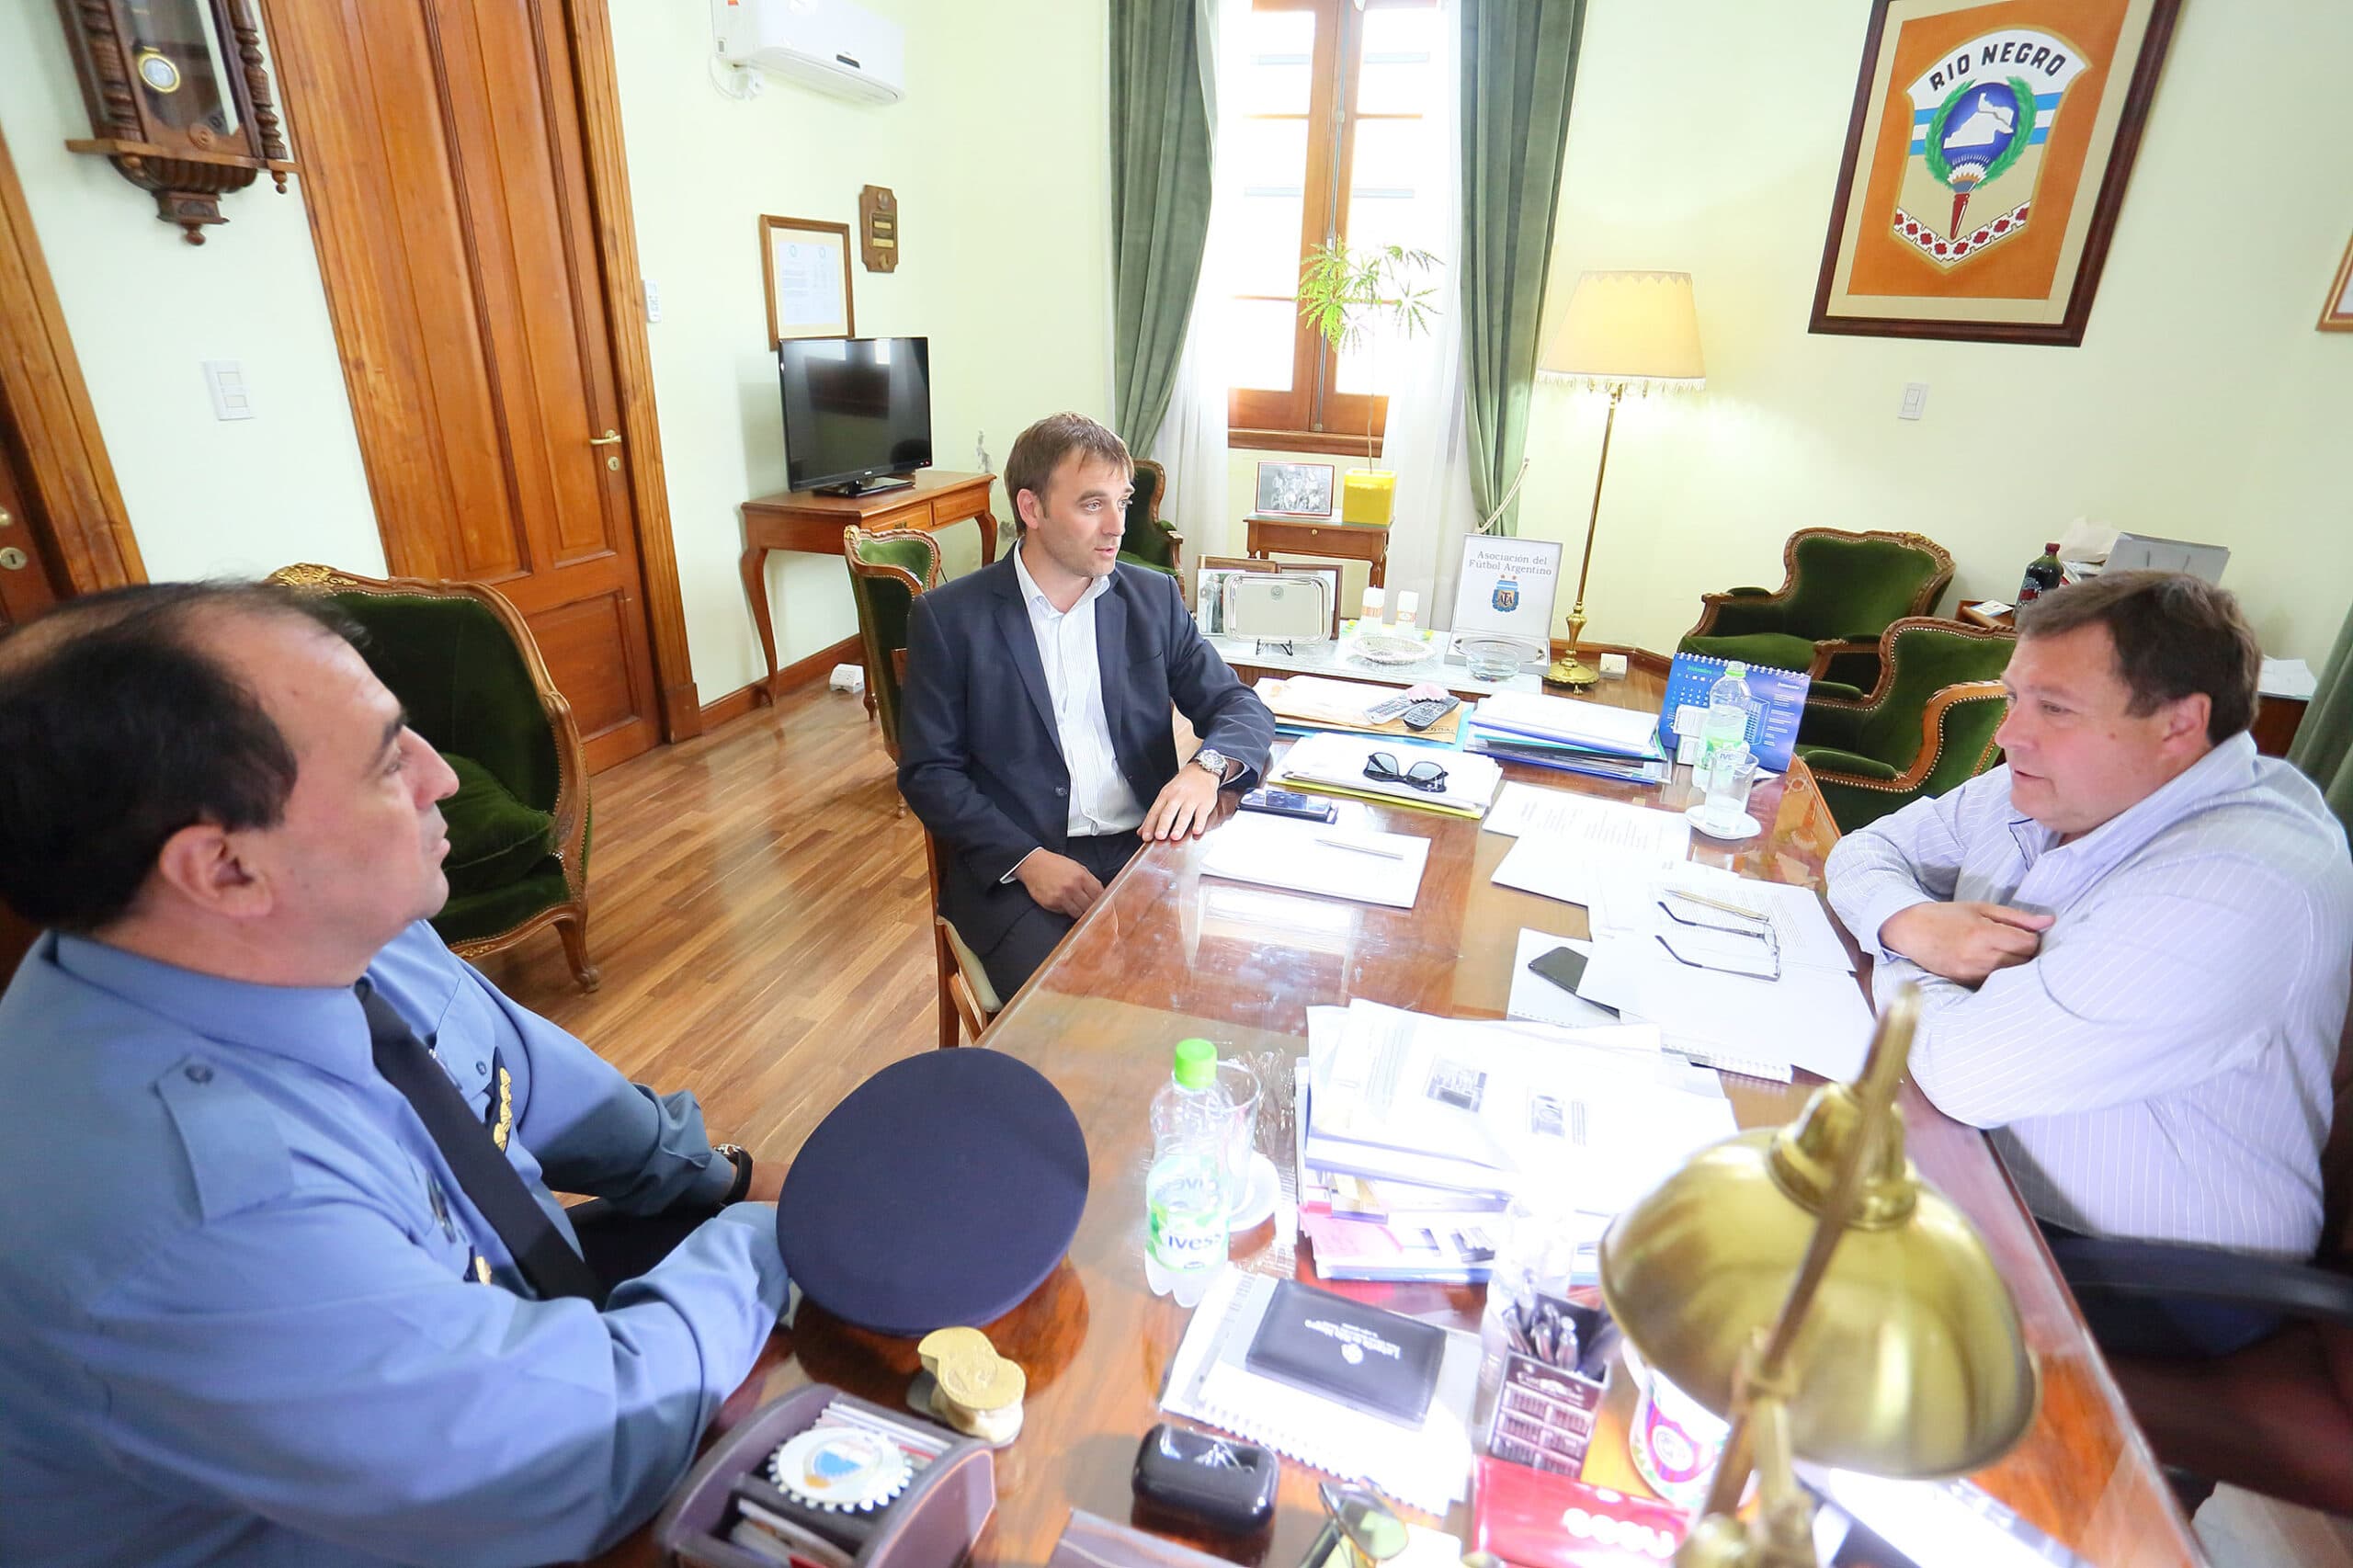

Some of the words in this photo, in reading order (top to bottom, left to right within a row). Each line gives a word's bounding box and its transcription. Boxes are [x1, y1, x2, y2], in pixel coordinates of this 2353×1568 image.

[1929, 54, 1971, 91] RIO
[1981, 41, 2066, 77] NEGRO
[1477, 551, 1529, 563] Asociación
[1532, 555, 1547, 565] del
[1503, 562, 1552, 575] Argentino
